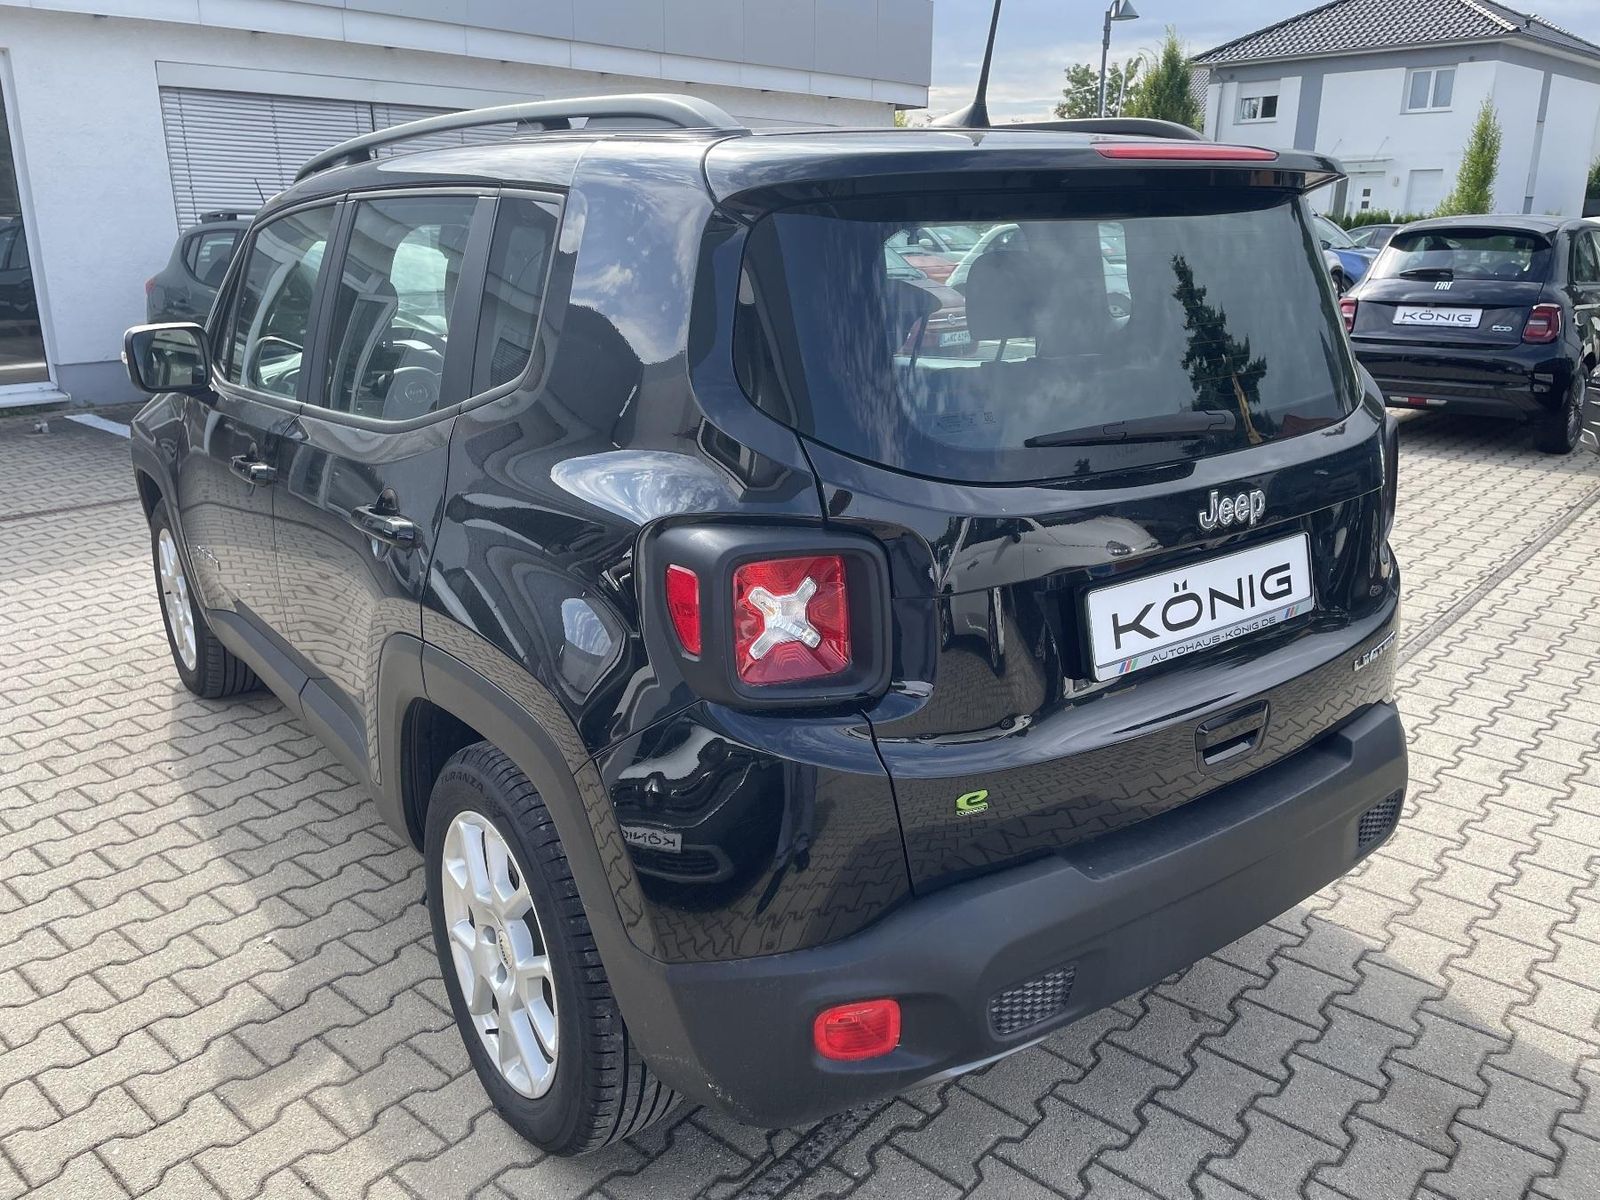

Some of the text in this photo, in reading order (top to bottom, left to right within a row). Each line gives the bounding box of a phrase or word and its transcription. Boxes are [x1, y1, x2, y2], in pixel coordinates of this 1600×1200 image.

[1434, 281, 1454, 291] FIAT
[1402, 309, 1472, 323] KÖNIG
[1200, 490, 1266, 530] Jeep
[1111, 563, 1292, 650] KÖNIG
[1150, 616, 1277, 664] AUTOHAUS-KÖNIG.DE
